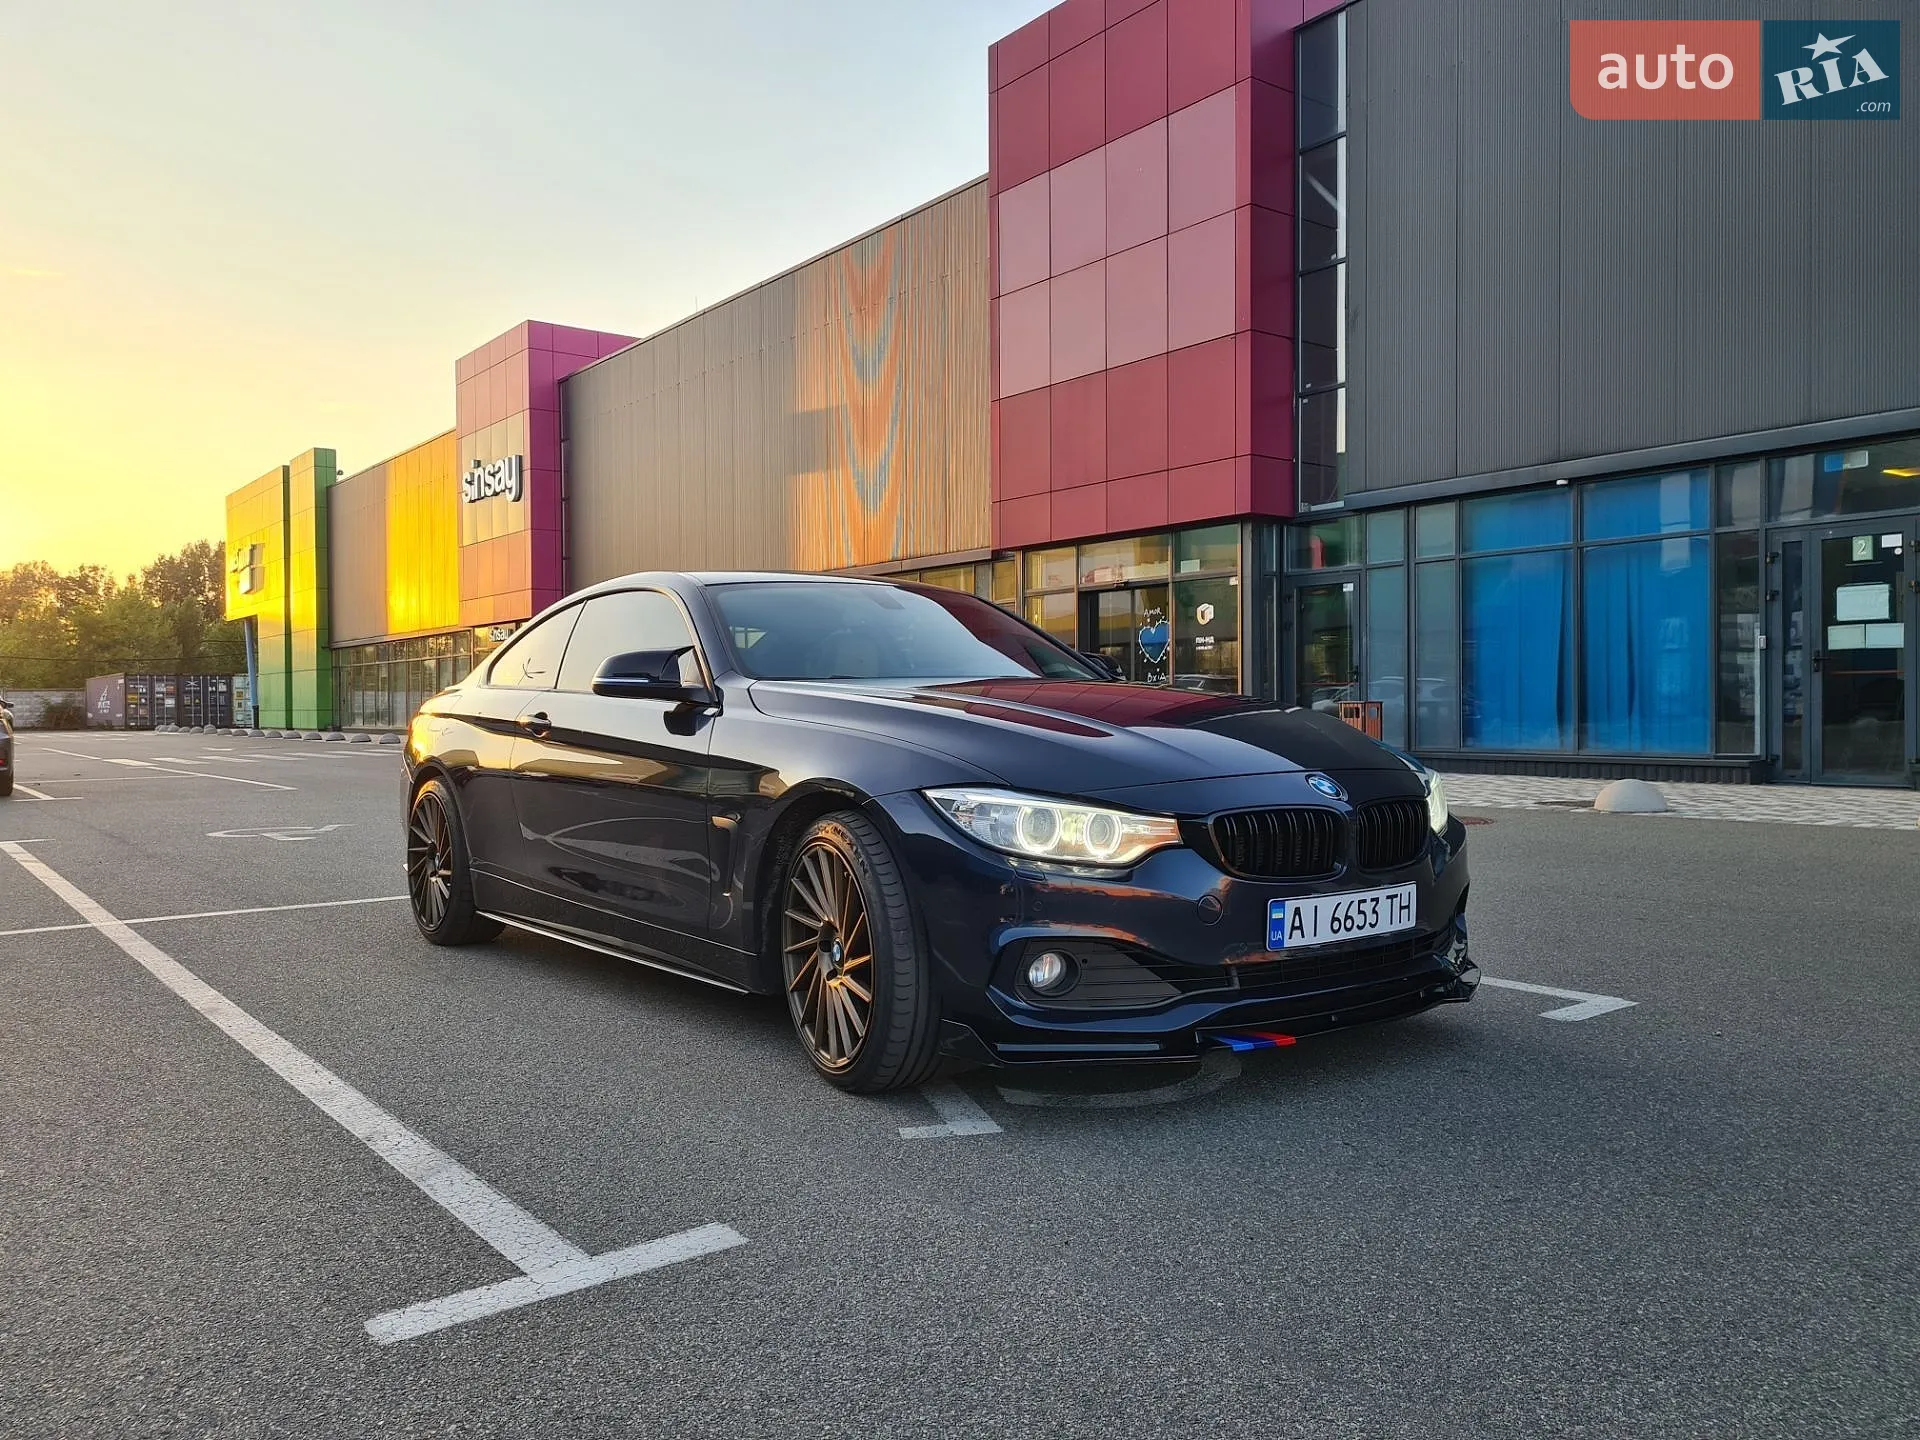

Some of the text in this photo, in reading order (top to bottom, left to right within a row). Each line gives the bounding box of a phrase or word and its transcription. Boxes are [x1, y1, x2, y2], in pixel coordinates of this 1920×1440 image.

[462, 454, 522, 503] sinsay
[1857, 540, 1867, 555] 2
[1288, 891, 1411, 940] AI 6653 TH
[1271, 931, 1283, 941] UA
